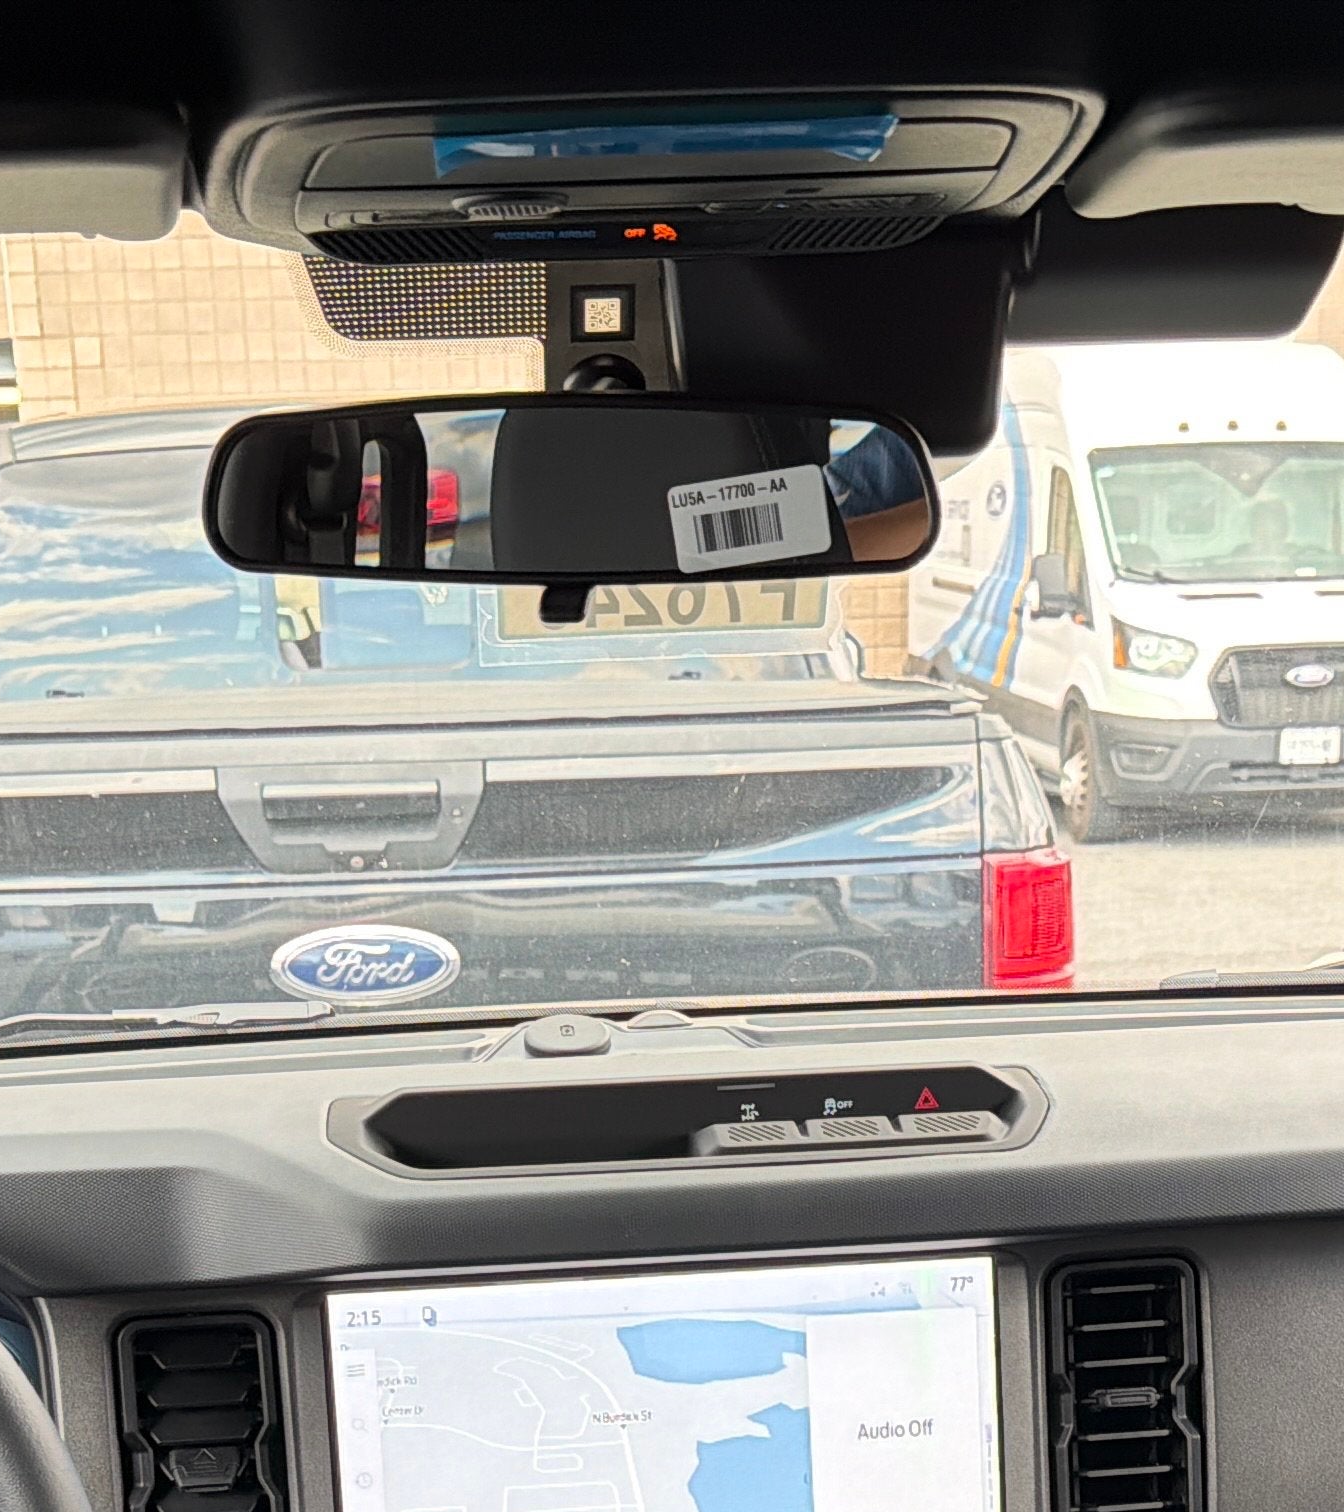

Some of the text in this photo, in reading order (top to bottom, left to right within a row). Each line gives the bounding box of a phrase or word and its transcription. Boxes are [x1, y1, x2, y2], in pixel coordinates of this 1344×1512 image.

[558, 230, 596, 239] AIRBAG
[624, 228, 646, 238] OFF
[317, 943, 416, 986] Ford
[837, 1100, 854, 1109] OFF
[346, 1310, 382, 1327] 2:15
[857, 1418, 935, 1440] Audio Off
